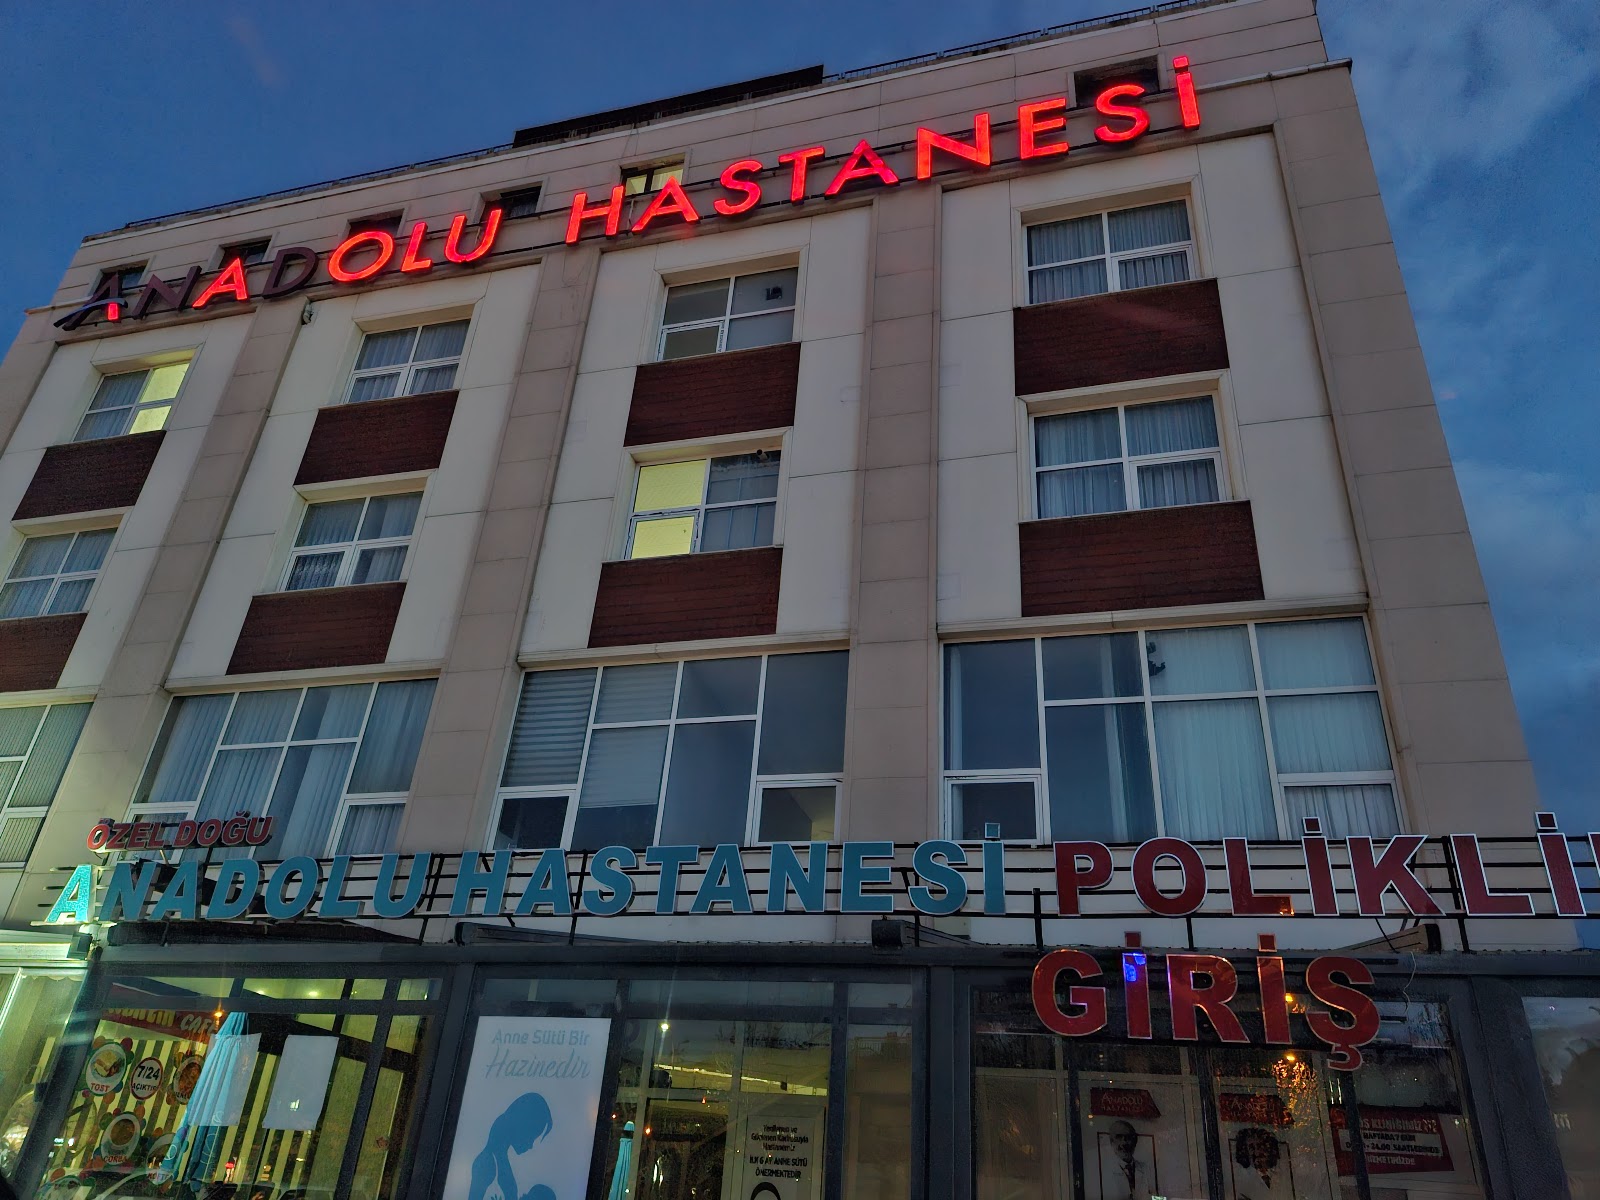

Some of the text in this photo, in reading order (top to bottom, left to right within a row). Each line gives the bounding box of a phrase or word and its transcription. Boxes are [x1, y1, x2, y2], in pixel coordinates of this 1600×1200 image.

[56, 55, 1203, 331] ANADOLU HASTANESİ
[87, 809, 276, 853] ÖZEL DOĞU
[44, 852, 431, 924] ANADOLU
[448, 821, 1007, 917] HASTANESİ
[1031, 930, 1381, 1072] GİRİŞ
[492, 1028, 591, 1046] Anne Sütü Bir
[137, 1065, 160, 1081] 7/24
[485, 1045, 591, 1079] Hazinedir
[90, 1082, 110, 1093] TOST
